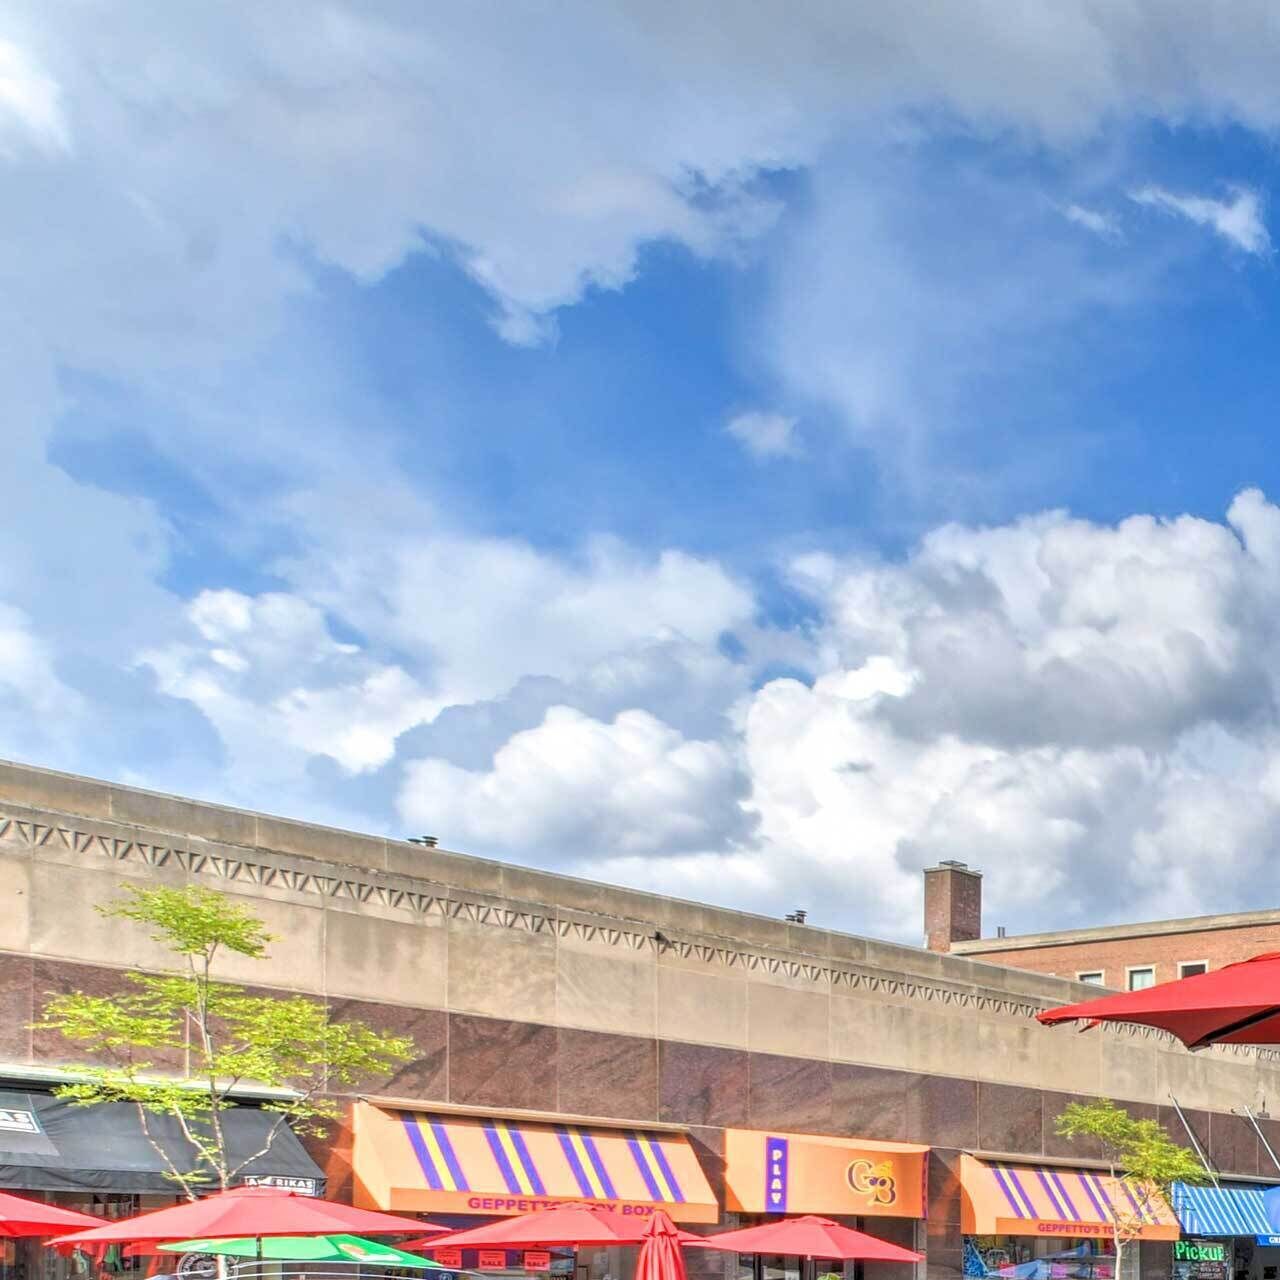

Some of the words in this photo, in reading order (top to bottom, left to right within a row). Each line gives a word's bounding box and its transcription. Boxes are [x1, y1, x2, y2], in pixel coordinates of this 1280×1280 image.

[771, 1149, 784, 1204] PLAY
[248, 1177, 313, 1189] ARIKAS
[622, 1205, 655, 1216] BOX
[1038, 1223, 1100, 1234] GEPPETTO'S
